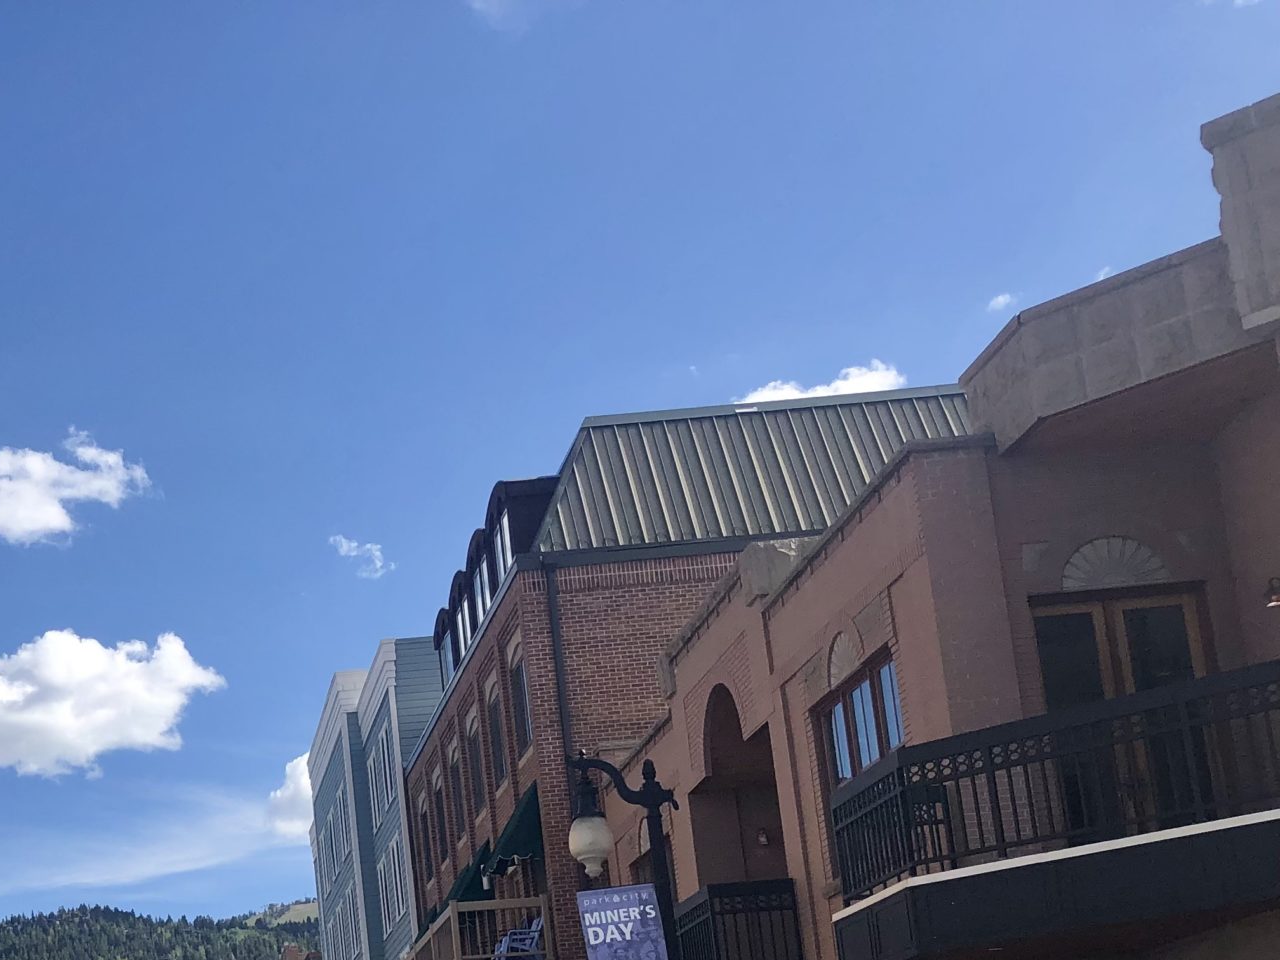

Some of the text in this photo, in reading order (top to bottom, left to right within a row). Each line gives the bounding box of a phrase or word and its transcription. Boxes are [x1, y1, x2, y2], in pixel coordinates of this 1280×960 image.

[584, 892, 648, 906] park city
[584, 905, 656, 926] MINER'S
[587, 921, 634, 945] DAY
